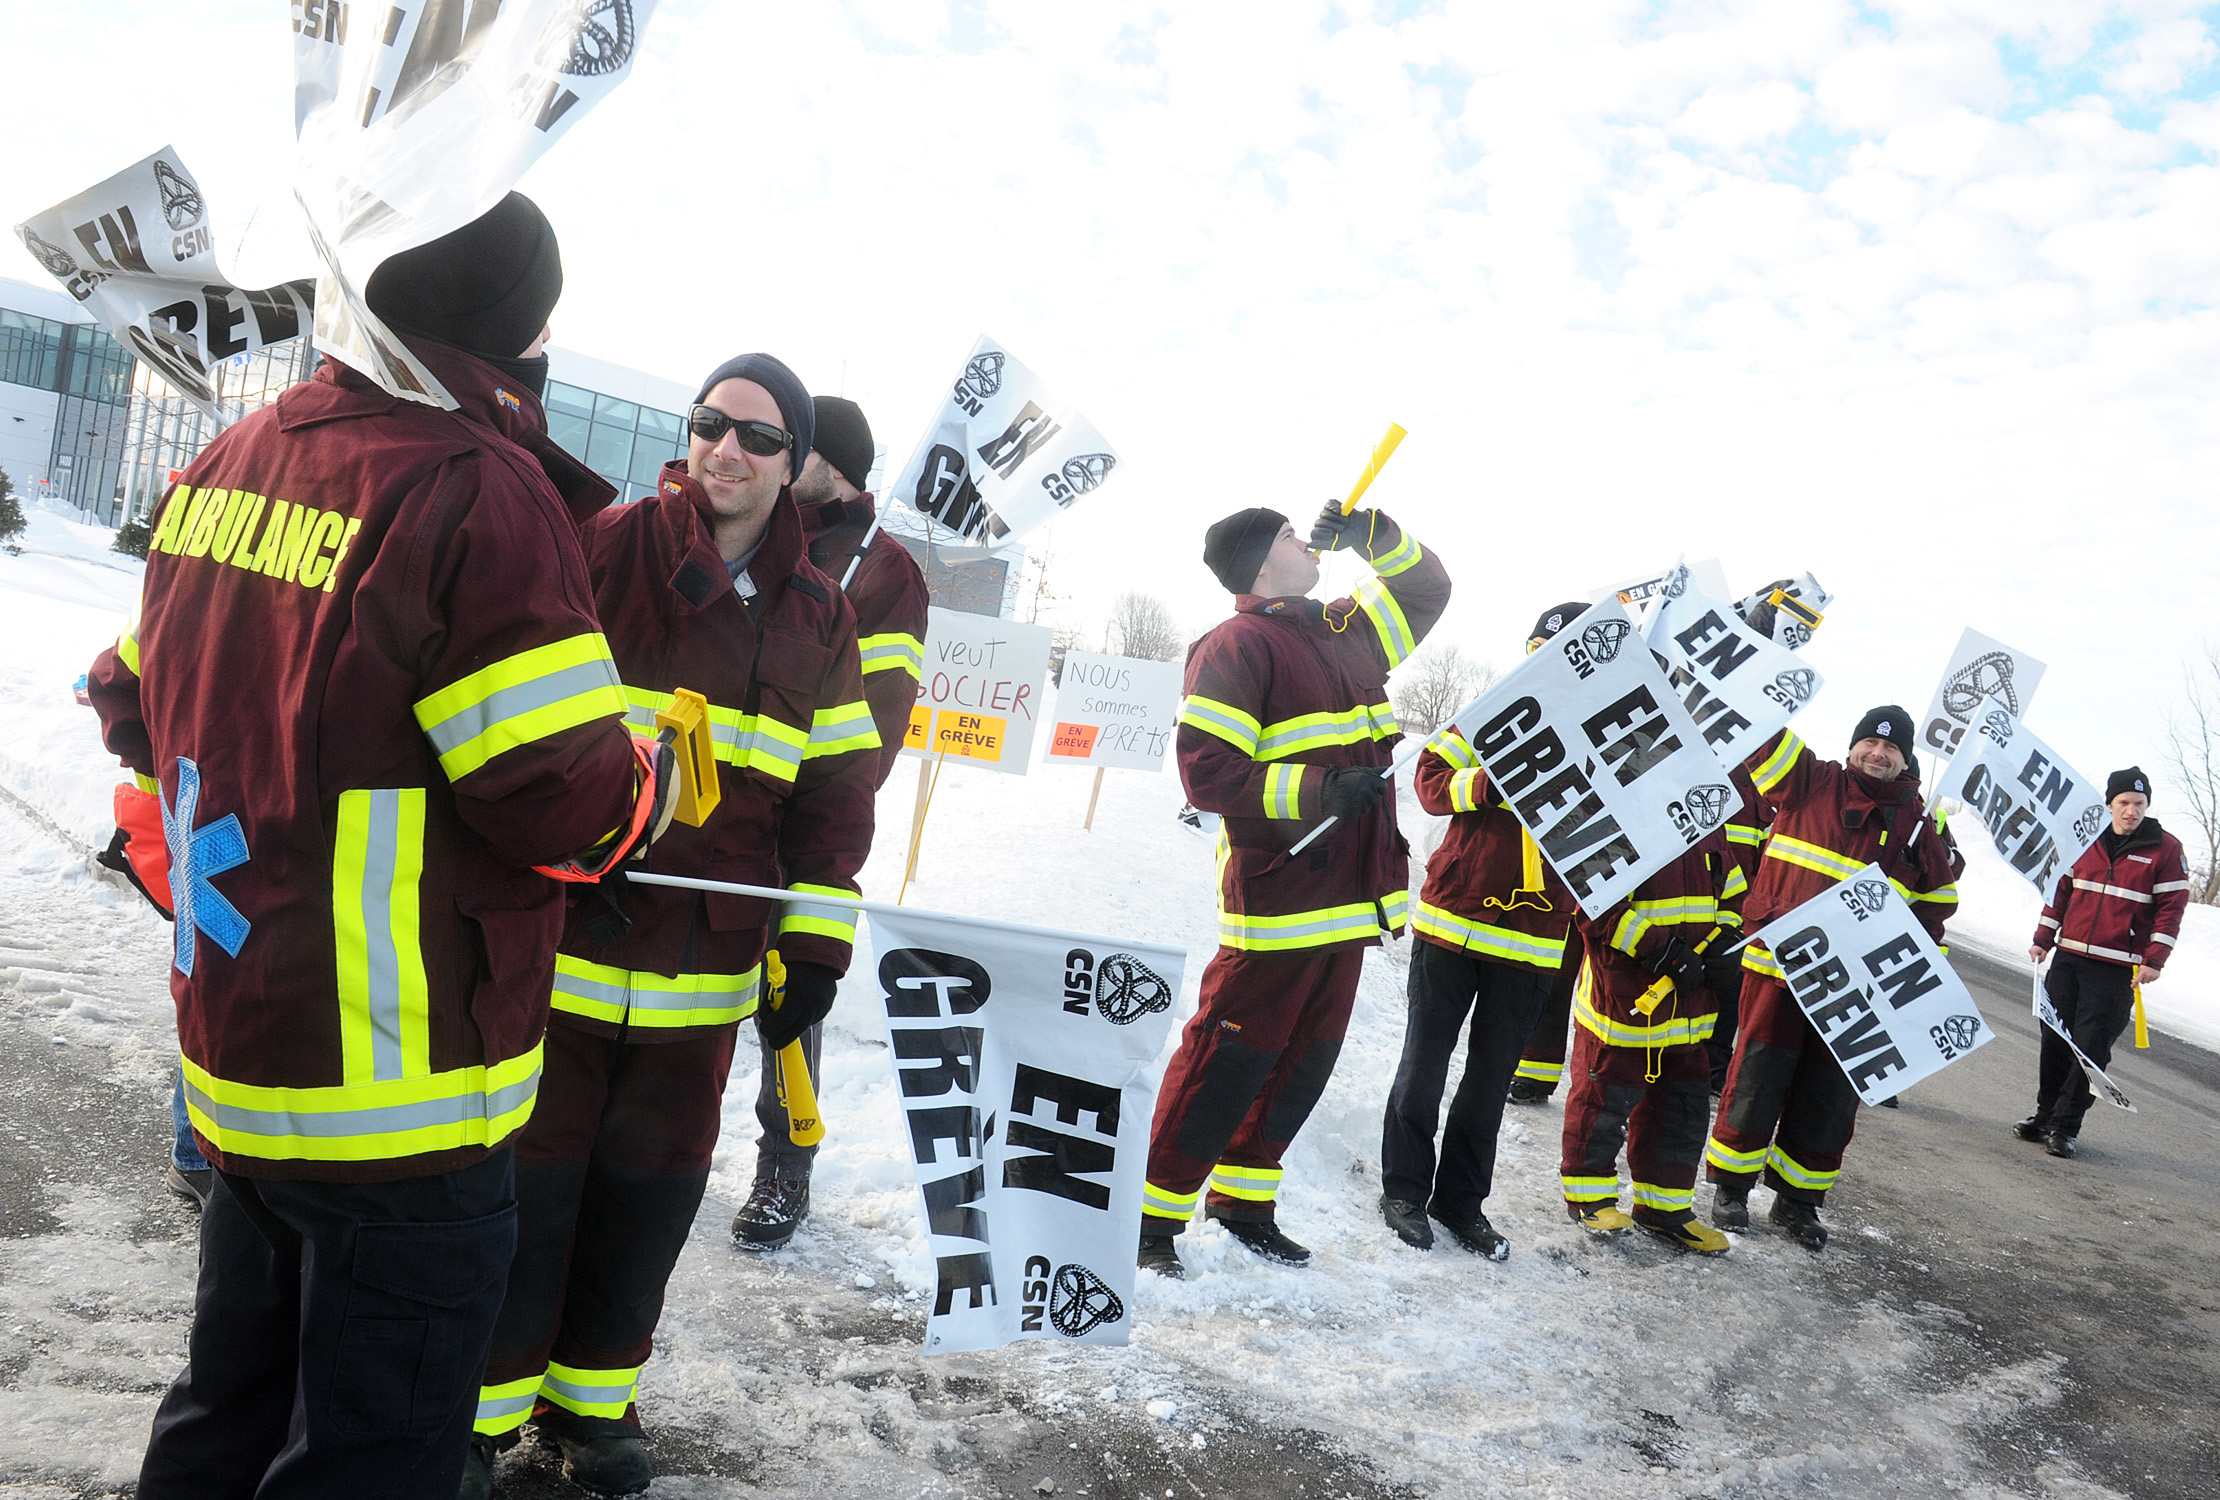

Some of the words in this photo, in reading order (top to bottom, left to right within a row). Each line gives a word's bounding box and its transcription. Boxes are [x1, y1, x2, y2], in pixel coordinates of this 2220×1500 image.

[172, 226, 211, 262] CSN
[953, 377, 984, 418] SN
[976, 400, 1062, 481] EN
[1629, 588, 1646, 601] EN
[1563, 638, 1595, 680] CSN
[1674, 609, 1760, 681] EN
[1783, 626, 1800, 651] CSN
[1070, 662, 1131, 692] NOUS
[1762, 684, 1799, 714] CSN
[940, 729, 996, 749] GRÈVE
[958, 715, 981, 730] EN
[1056, 736, 1091, 749] GRÈVE
[1068, 726, 1083, 736] EN
[1580, 683, 1683, 788] EN
[1978, 725, 2008, 750] CSN
[1472, 695, 1641, 900] GRÈVE
[2016, 748, 2075, 816] EN
[1665, 800, 1701, 845] CSN
[1961, 763, 2061, 895] GRÈVE
[2072, 819, 2091, 848] CSN
[1839, 889, 1870, 923] CSN
[1063, 948, 1094, 1016] CSN
[1861, 931, 1943, 1011] EN
[1775, 925, 1908, 1094] GRÈVE
[1928, 1024, 1958, 1061] CSN
[878, 947, 998, 1317] GRÈVE
[1002, 1062, 1122, 1211] EN
[1021, 1254, 1051, 1332] CSN
